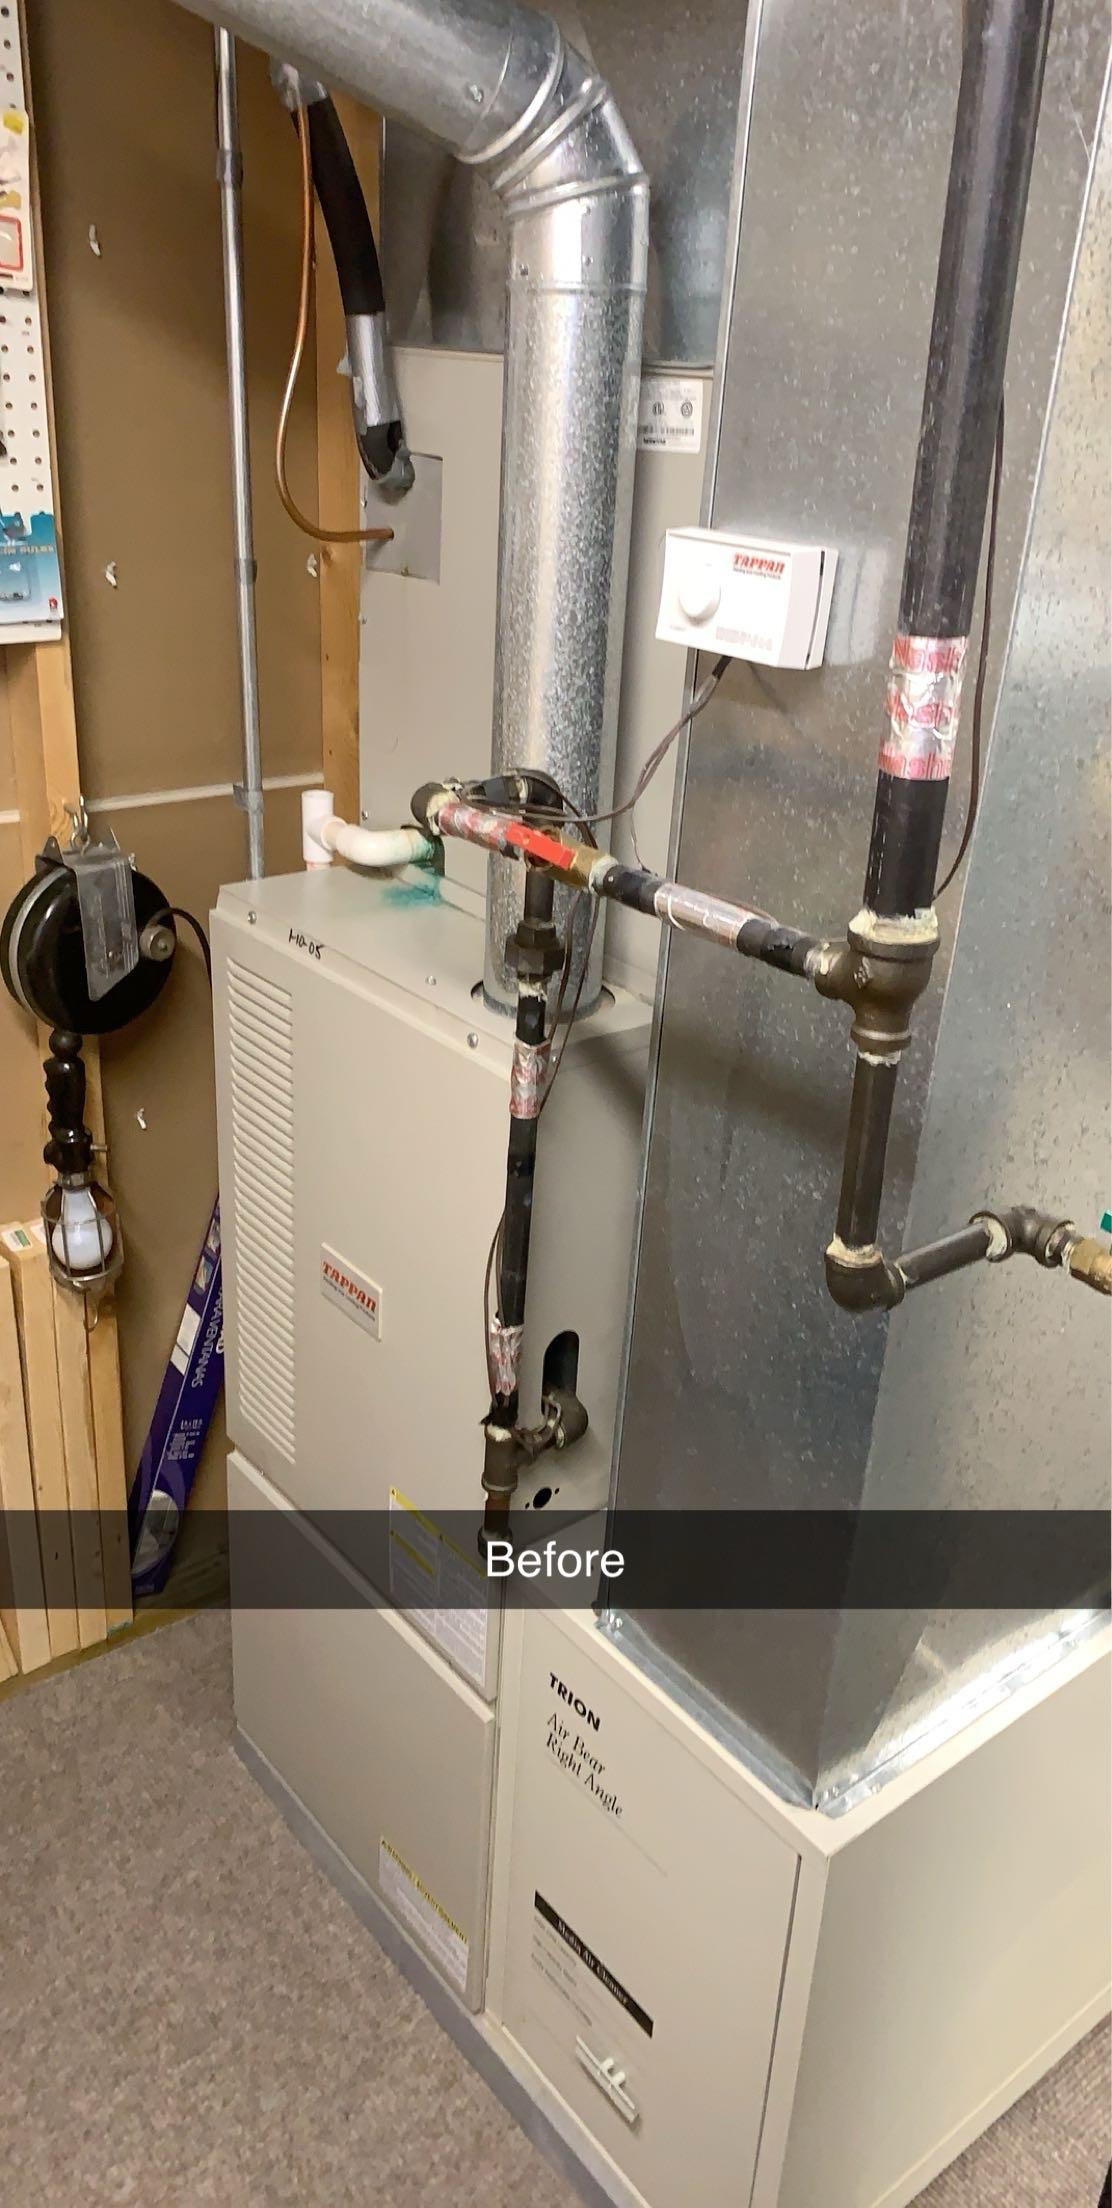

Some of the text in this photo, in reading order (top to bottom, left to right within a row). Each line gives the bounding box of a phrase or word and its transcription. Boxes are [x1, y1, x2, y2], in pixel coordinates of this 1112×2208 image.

[734, 552, 785, 574] TAPPAN
[322, 1260, 376, 1314] TAPPAN
[549, 1672, 600, 1732] TRION
[547, 1713, 606, 1775] Air Bear
[546, 1732, 623, 1817] Right Angle
